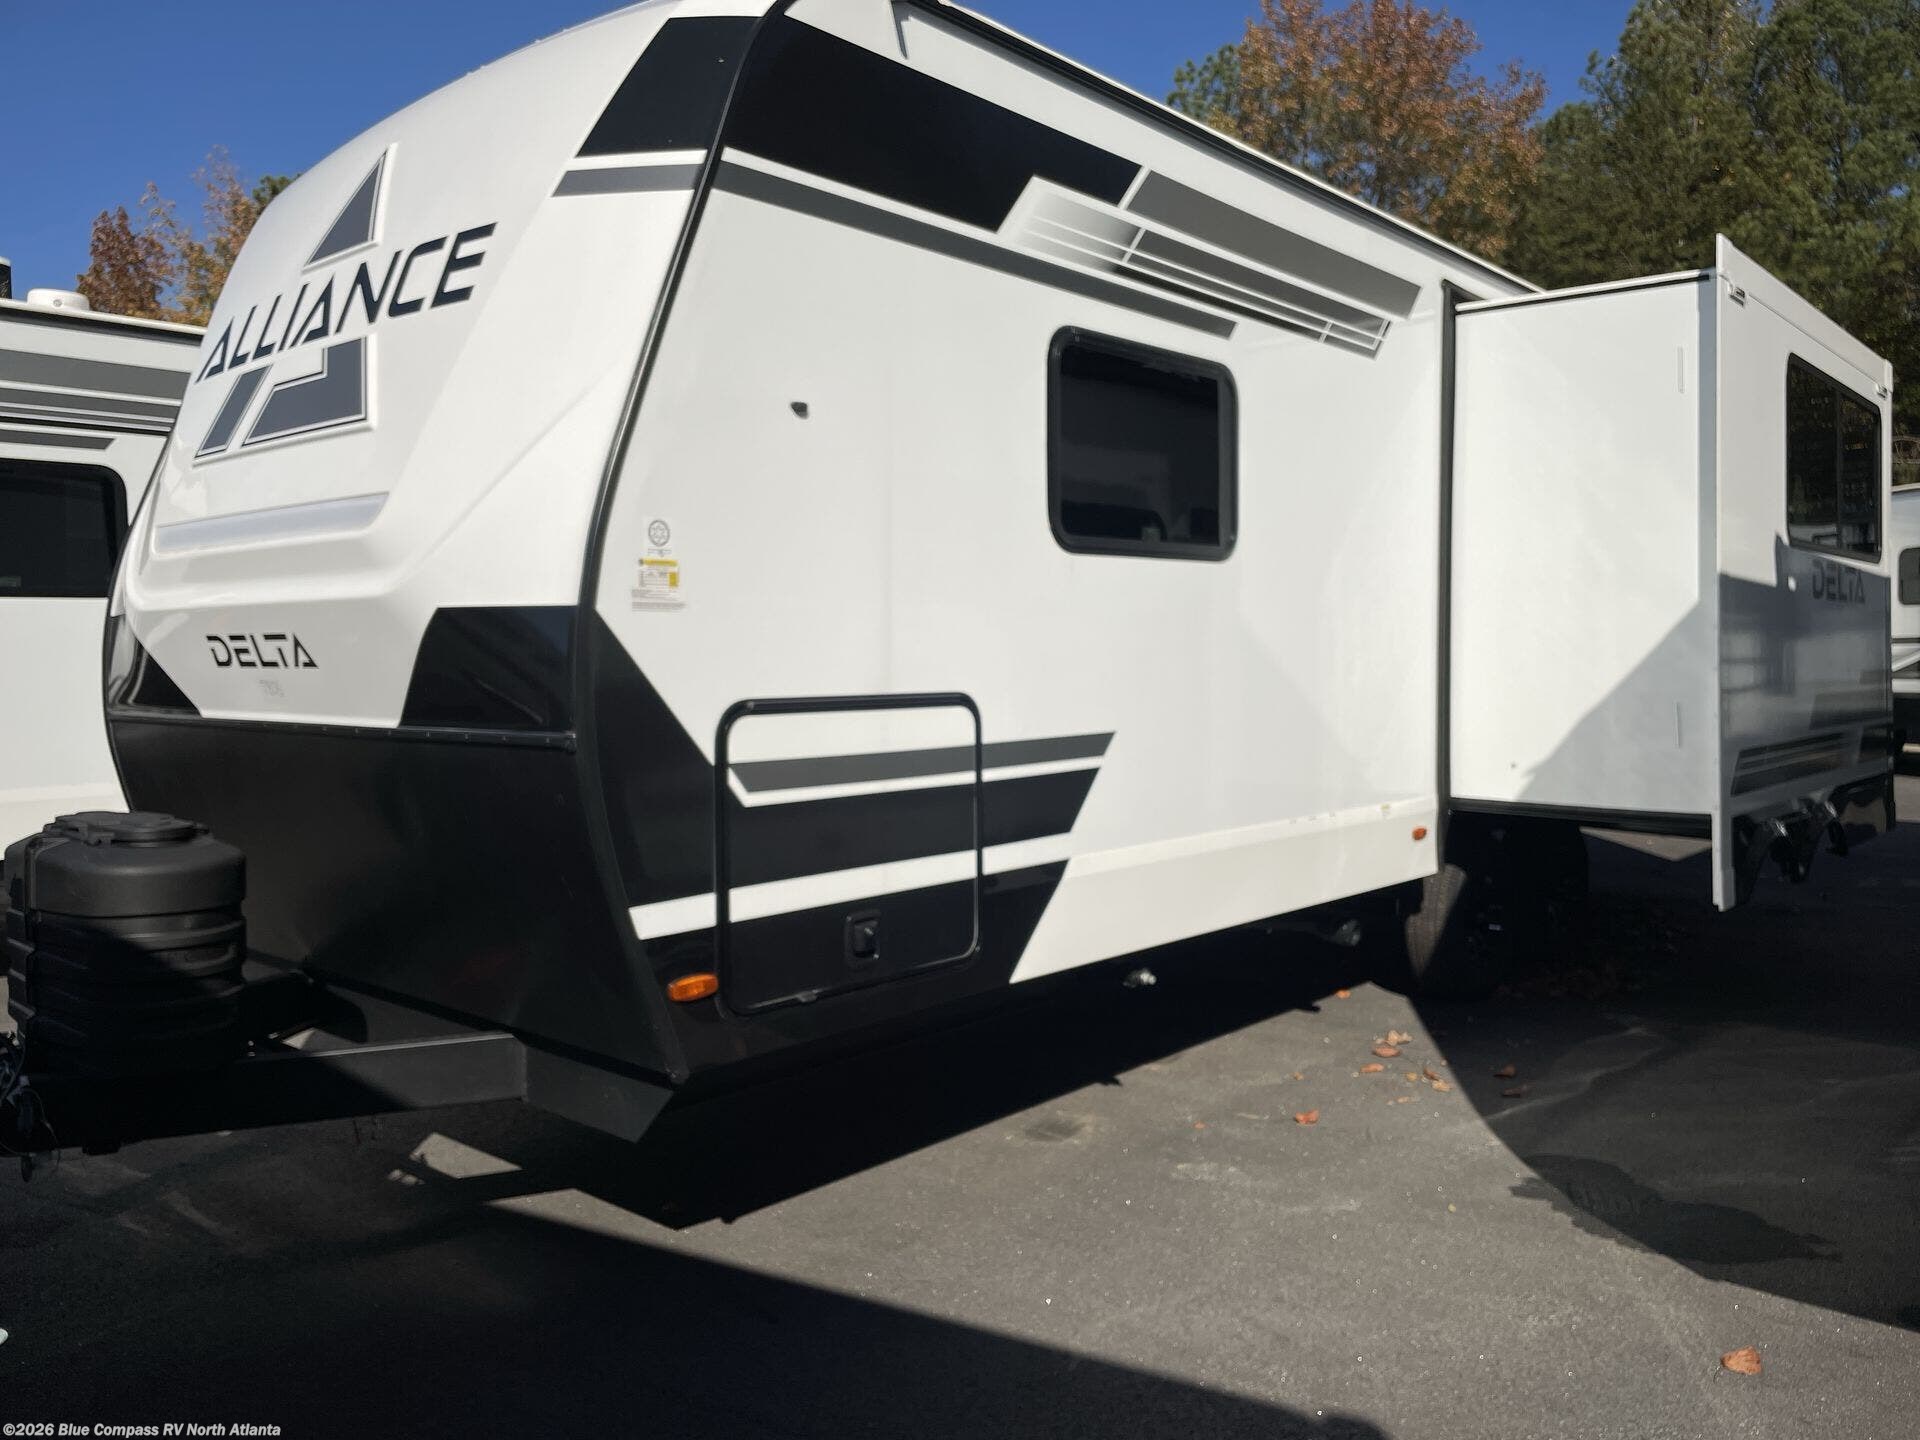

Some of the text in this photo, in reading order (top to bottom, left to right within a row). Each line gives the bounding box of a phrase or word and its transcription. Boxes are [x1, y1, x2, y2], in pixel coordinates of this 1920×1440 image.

[197, 222, 498, 382] ALLIANCE
[1811, 559, 1866, 604] DELTA
[206, 633, 319, 668] DELTA
